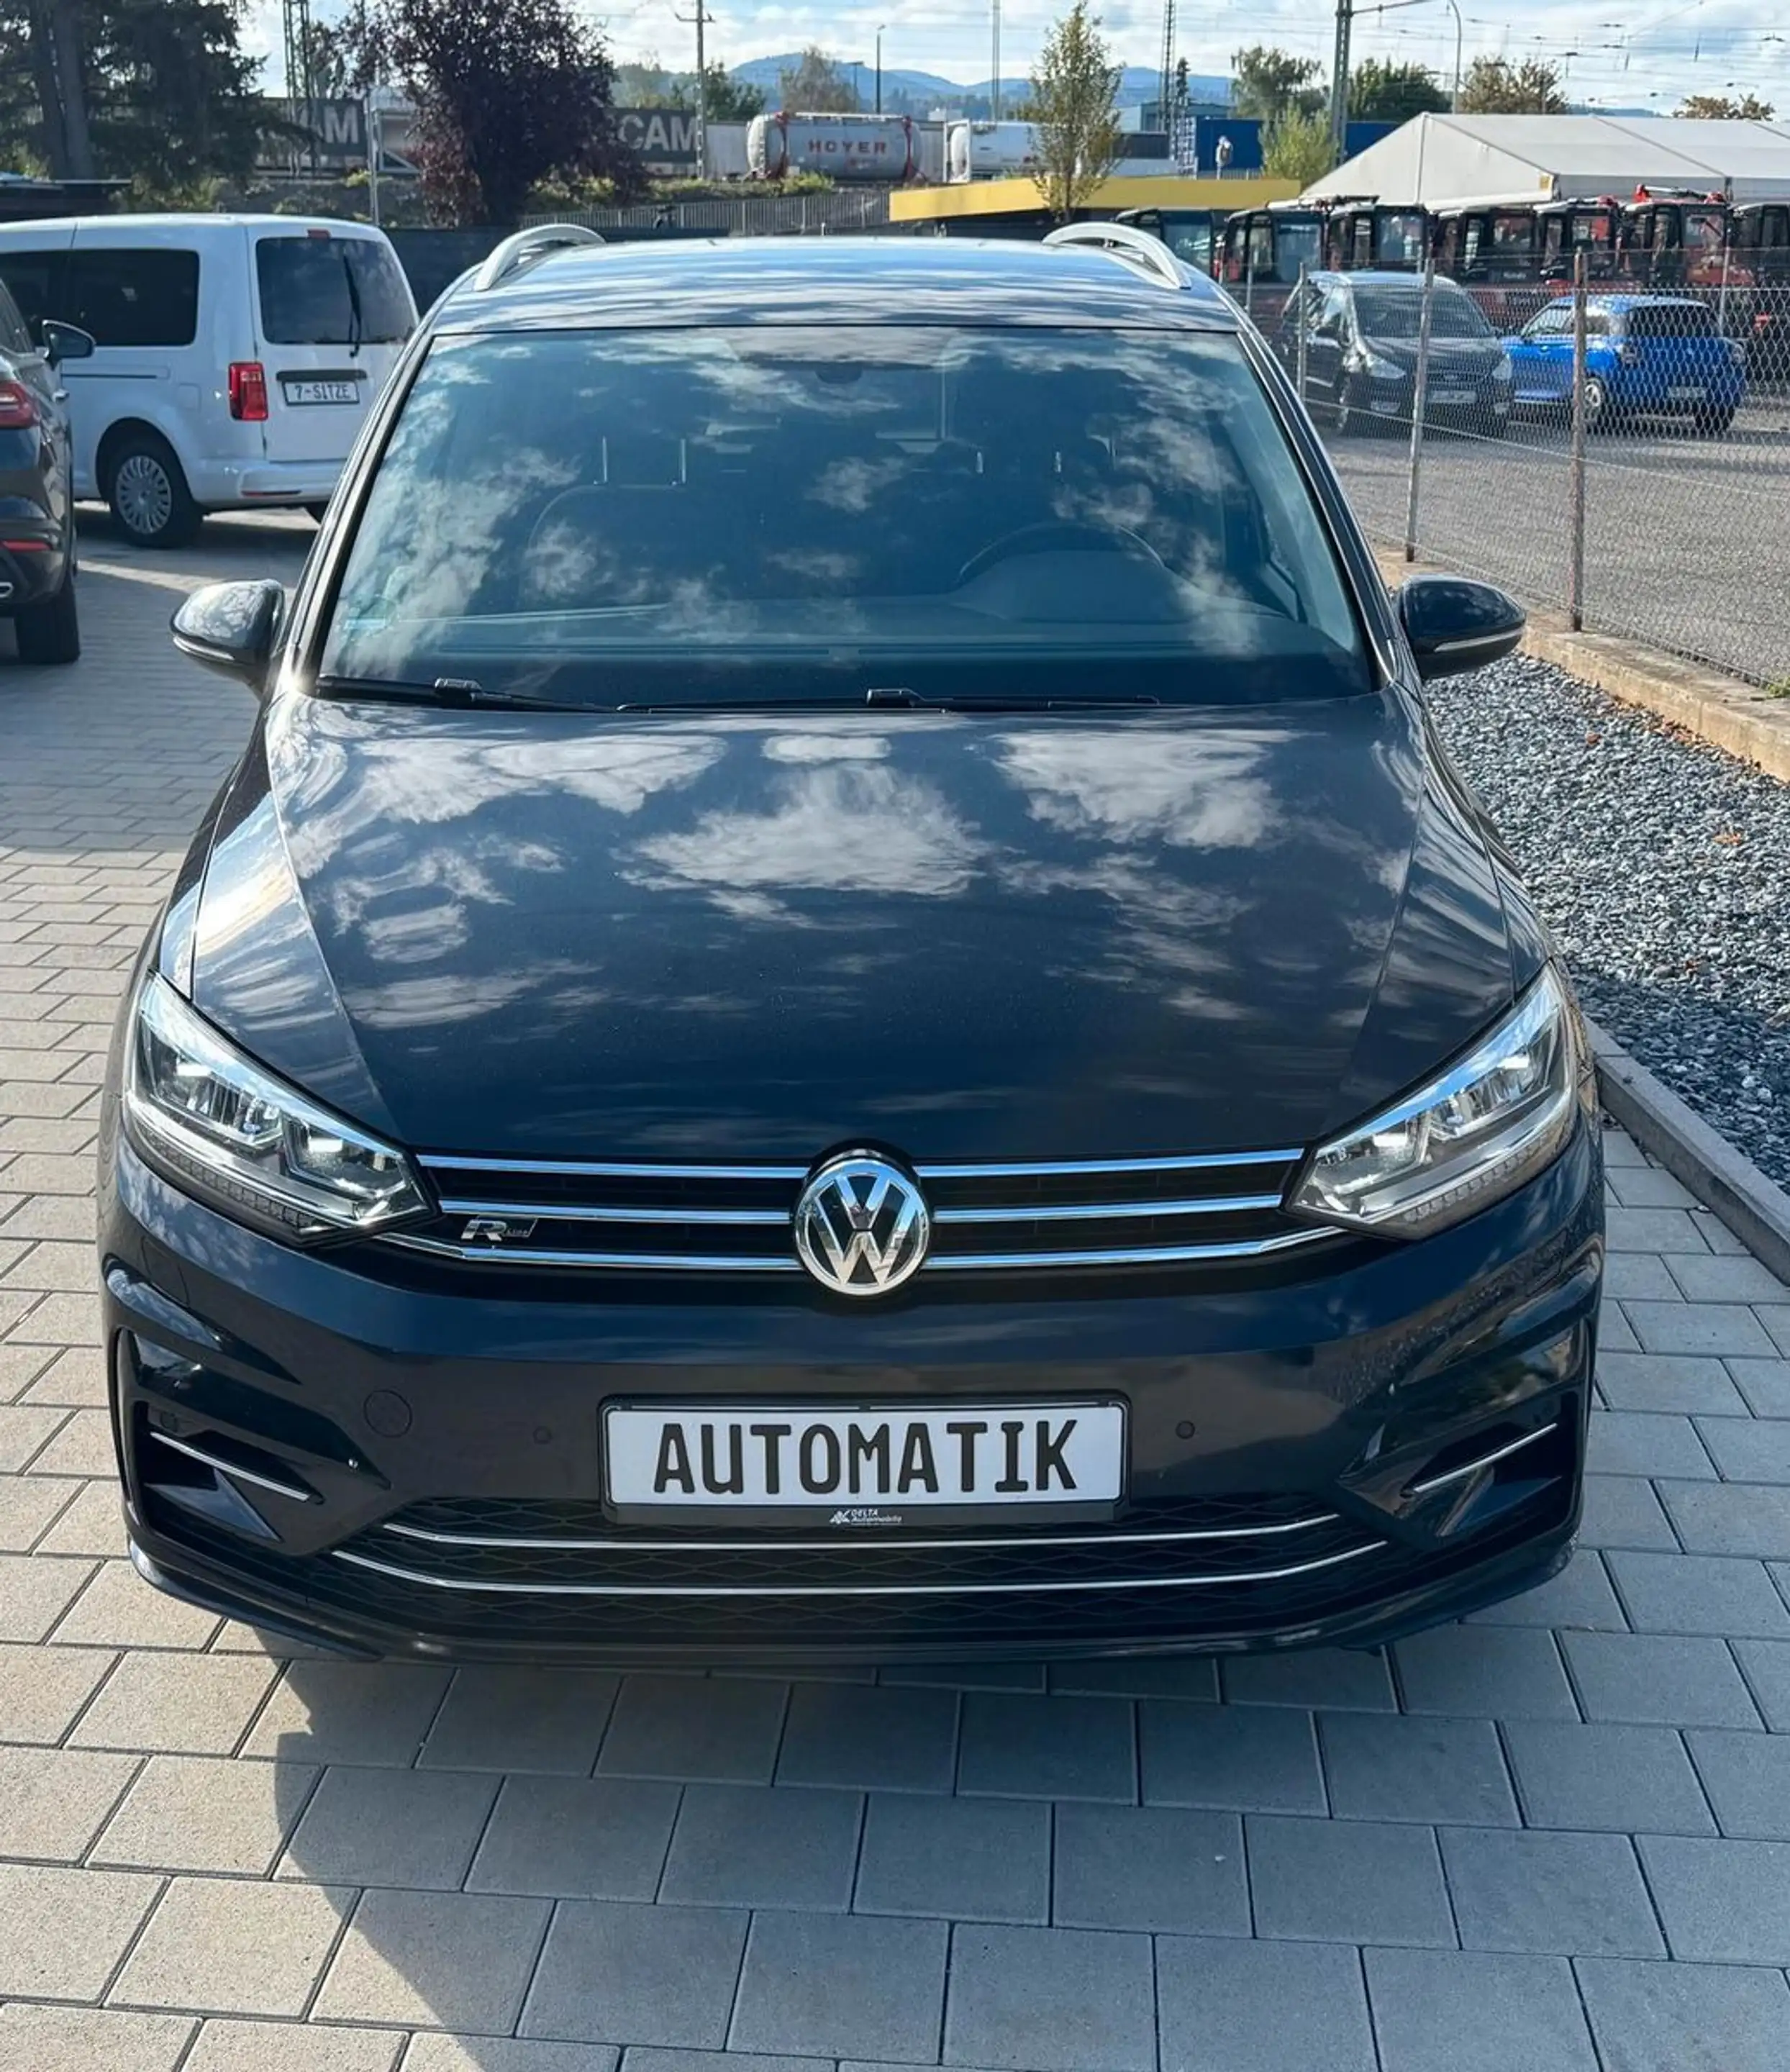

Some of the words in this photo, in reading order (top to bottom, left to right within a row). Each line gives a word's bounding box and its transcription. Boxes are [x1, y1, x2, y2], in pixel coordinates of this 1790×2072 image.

[809, 140, 886, 154] HOYER
[294, 385, 350, 400] 7-SITZE
[460, 1219, 506, 1241] R
[653, 1419, 1078, 1494] AUTOMATIK
